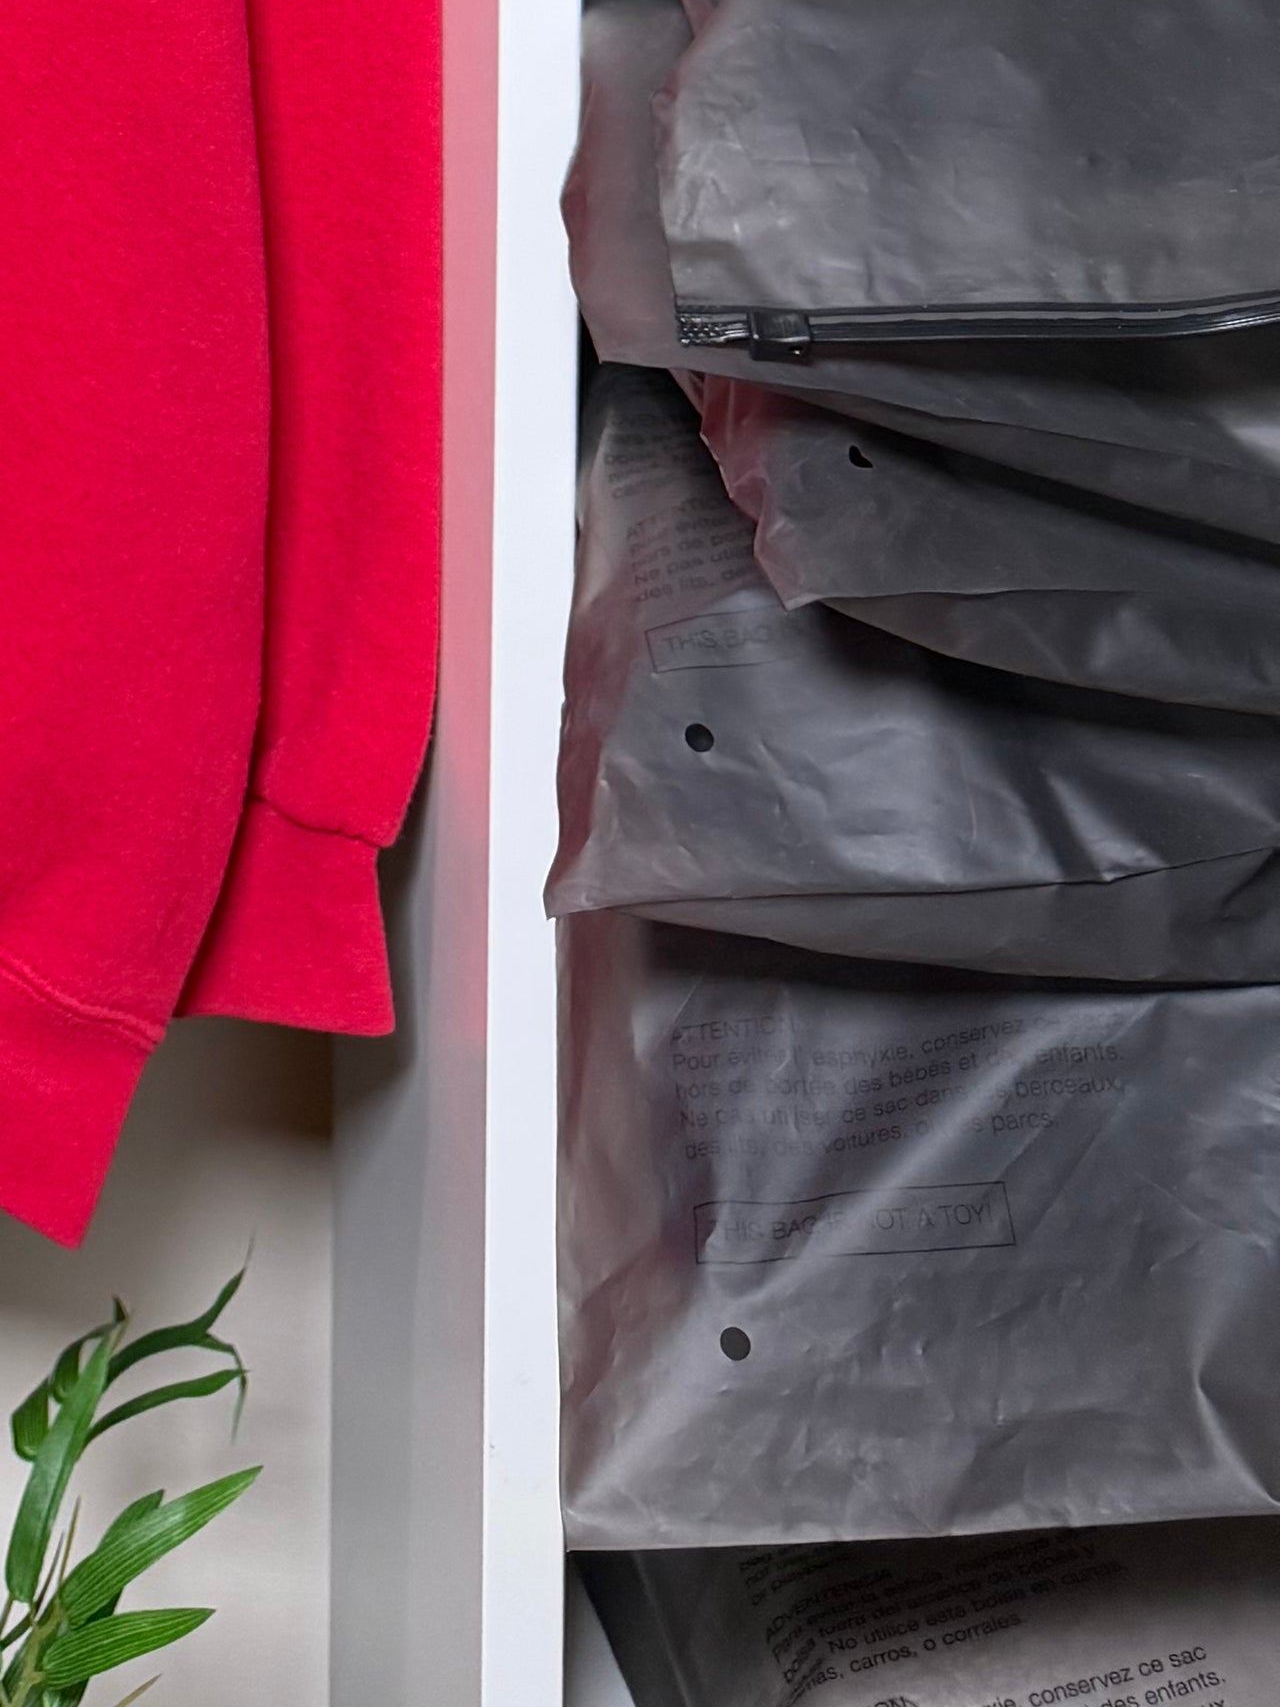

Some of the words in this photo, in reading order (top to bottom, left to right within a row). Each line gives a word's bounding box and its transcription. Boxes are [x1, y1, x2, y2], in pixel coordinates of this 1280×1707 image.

[673, 1052, 720, 1072] Pour
[921, 1018, 1024, 1054] conservez
[958, 1052, 978, 1071] et
[842, 1106, 867, 1124] ce
[872, 1096, 909, 1117] sac
[917, 1207, 936, 1229] A
[827, 1636, 859, 1654] No
[863, 1620, 920, 1645] utilice
[924, 1603, 968, 1627] esta
[970, 1585, 1028, 1612] bolsa
[848, 1644, 919, 1674] carros,
[922, 1637, 938, 1652] o
[1027, 1666, 1136, 1707] conservez
[1138, 1657, 1166, 1678] ce
[1168, 1645, 1208, 1668] sac
[1144, 1668, 1228, 1707] enfants.
